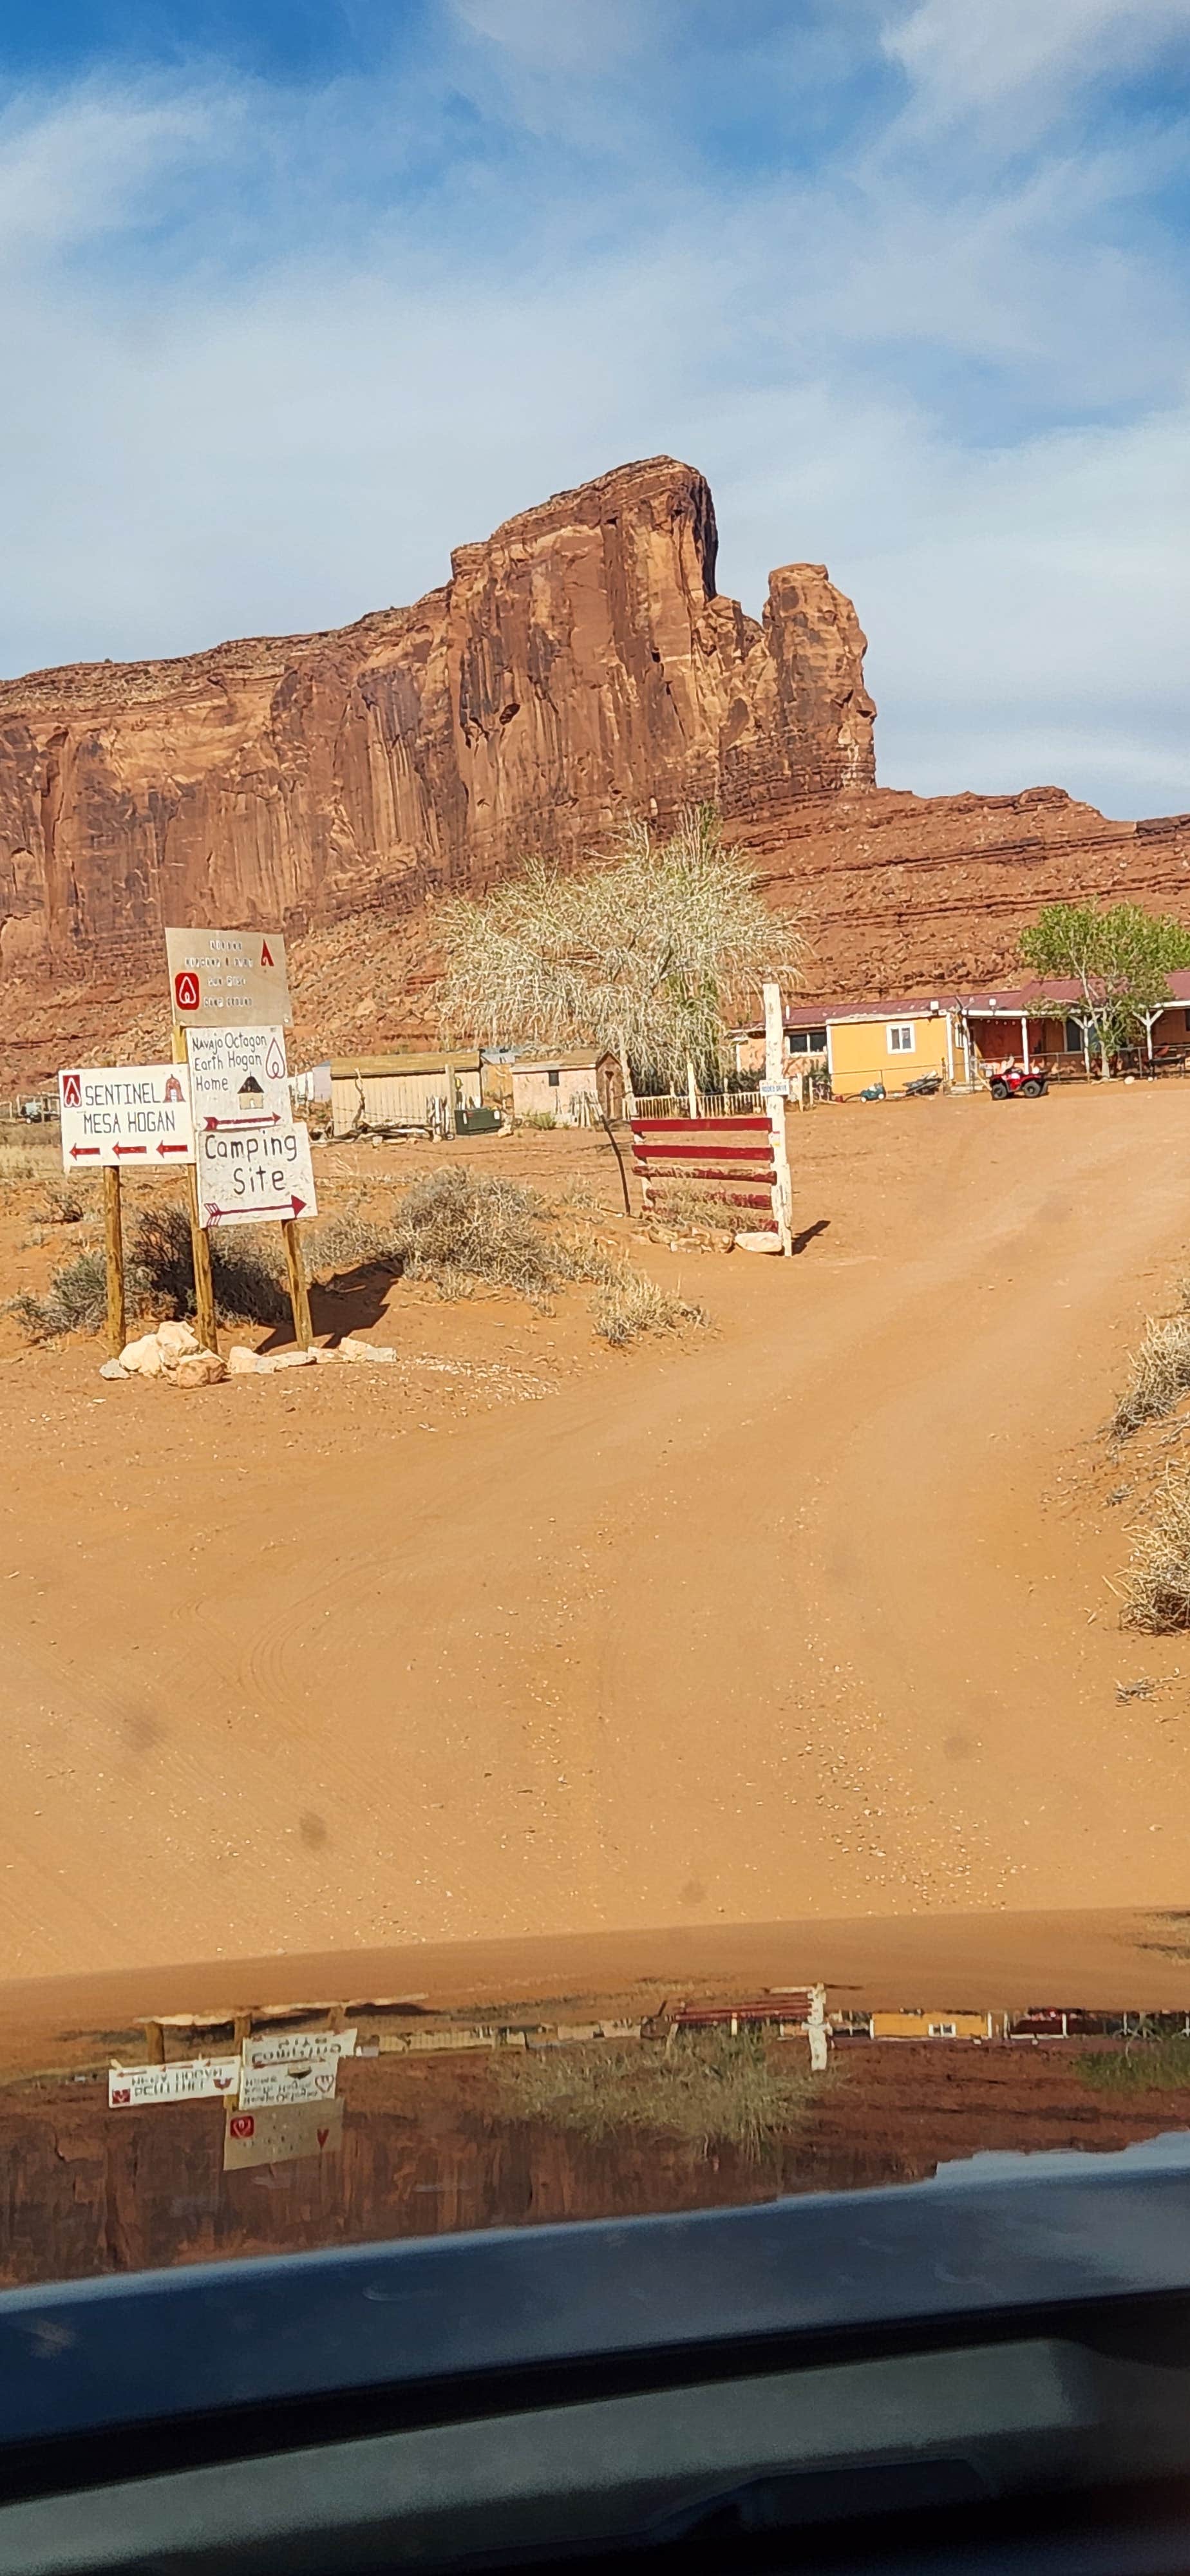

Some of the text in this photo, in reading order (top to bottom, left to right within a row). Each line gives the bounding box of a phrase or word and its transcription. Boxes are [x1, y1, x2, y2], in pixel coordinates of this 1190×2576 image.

[225, 1032, 267, 1053] Octagon
[194, 1050, 262, 1072] Earth Hogan
[85, 1083, 160, 1106] SENTINEL
[196, 1075, 229, 1091] Home
[84, 1110, 175, 1134] MESA HOGAN
[205, 1130, 298, 1162] Camping
[233, 1166, 286, 1195] Site
